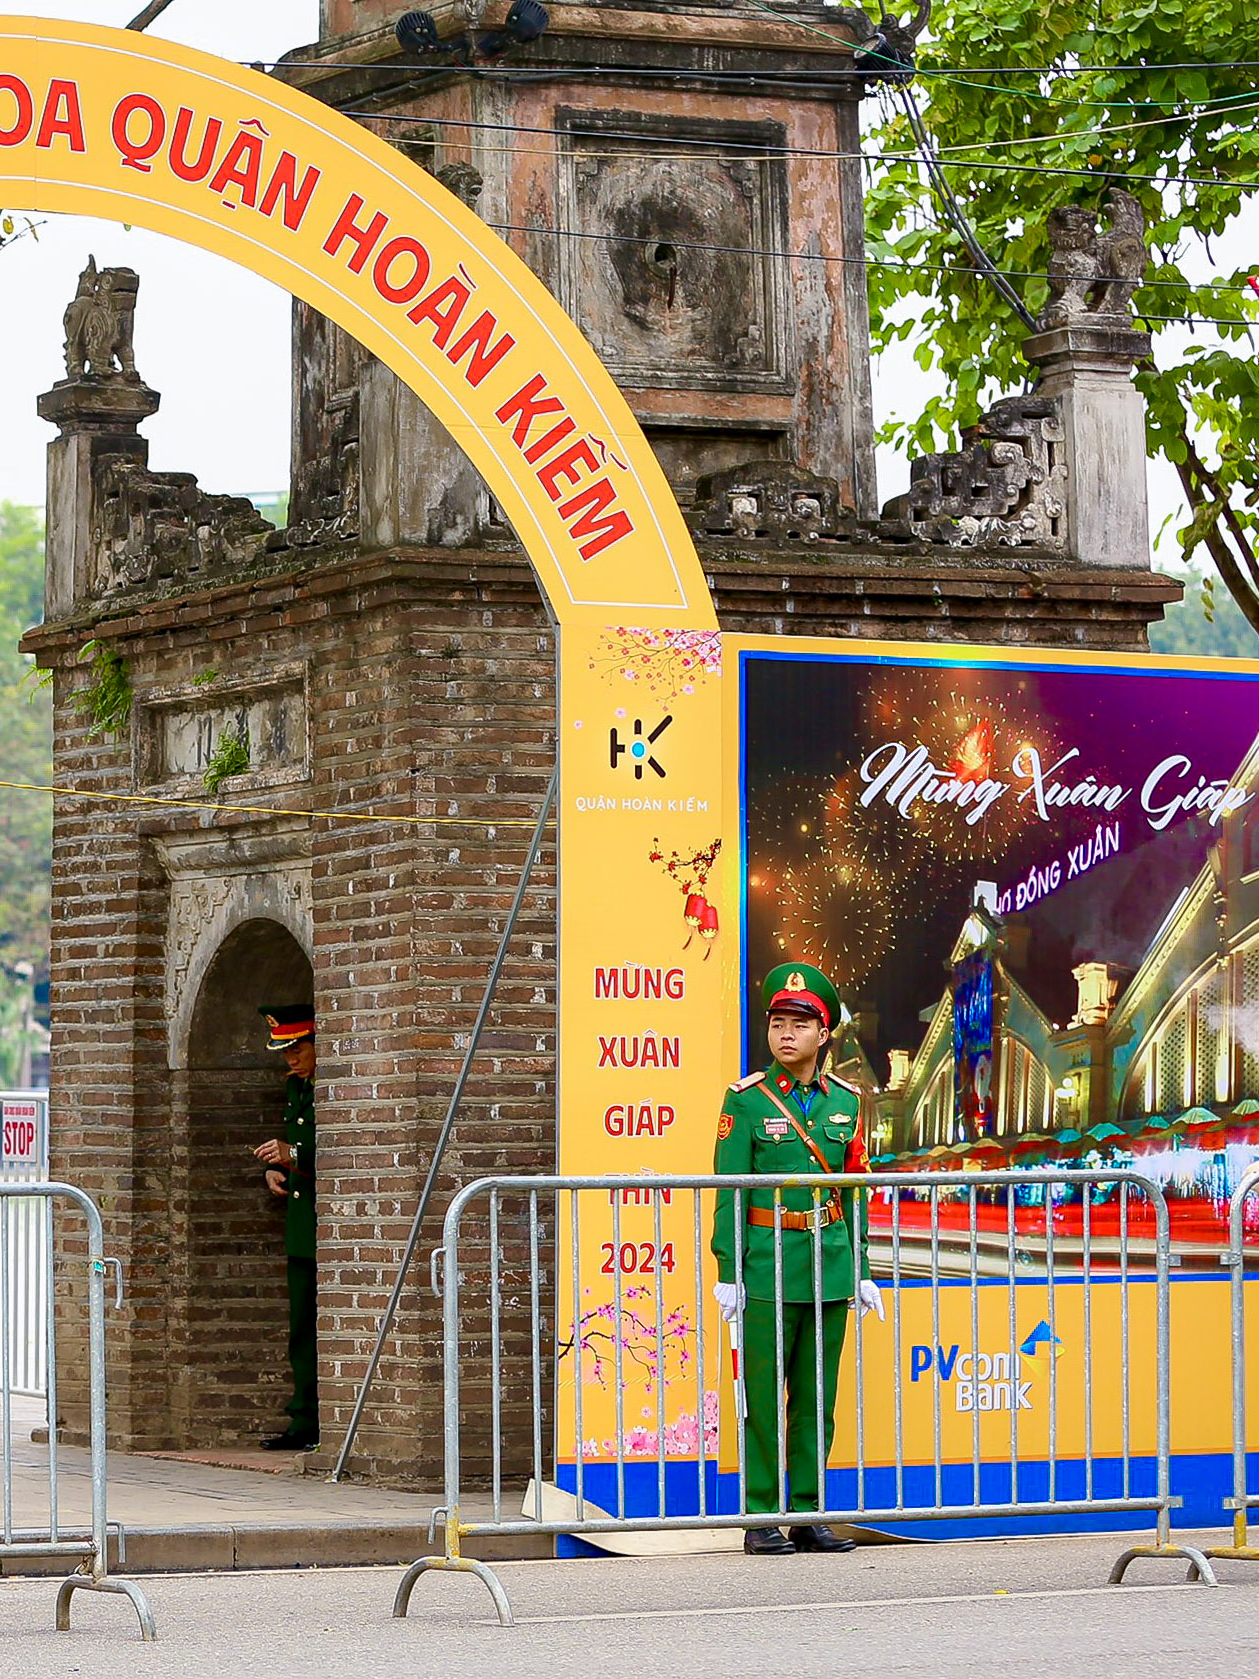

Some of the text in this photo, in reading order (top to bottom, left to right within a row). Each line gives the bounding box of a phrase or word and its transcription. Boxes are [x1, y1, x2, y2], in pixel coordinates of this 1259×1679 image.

[111, 93, 322, 232] QUẬN
[323, 193, 517, 389] HOÀN
[494, 372, 635, 562] KIẾM
[1012, 747, 1132, 821] Xuân
[575, 795, 709, 812] QUẬN HOÀN KIẾM
[1067, 821, 1120, 880] XUÂN
[594, 960, 685, 1000] MỪNG
[598, 1029, 680, 1068] XUÂN
[604, 1099, 676, 1137] GIÁP
[3, 1121, 35, 1156] STOP
[601, 1242, 676, 1274] 2024
[956, 1381, 1033, 1412] Bank
